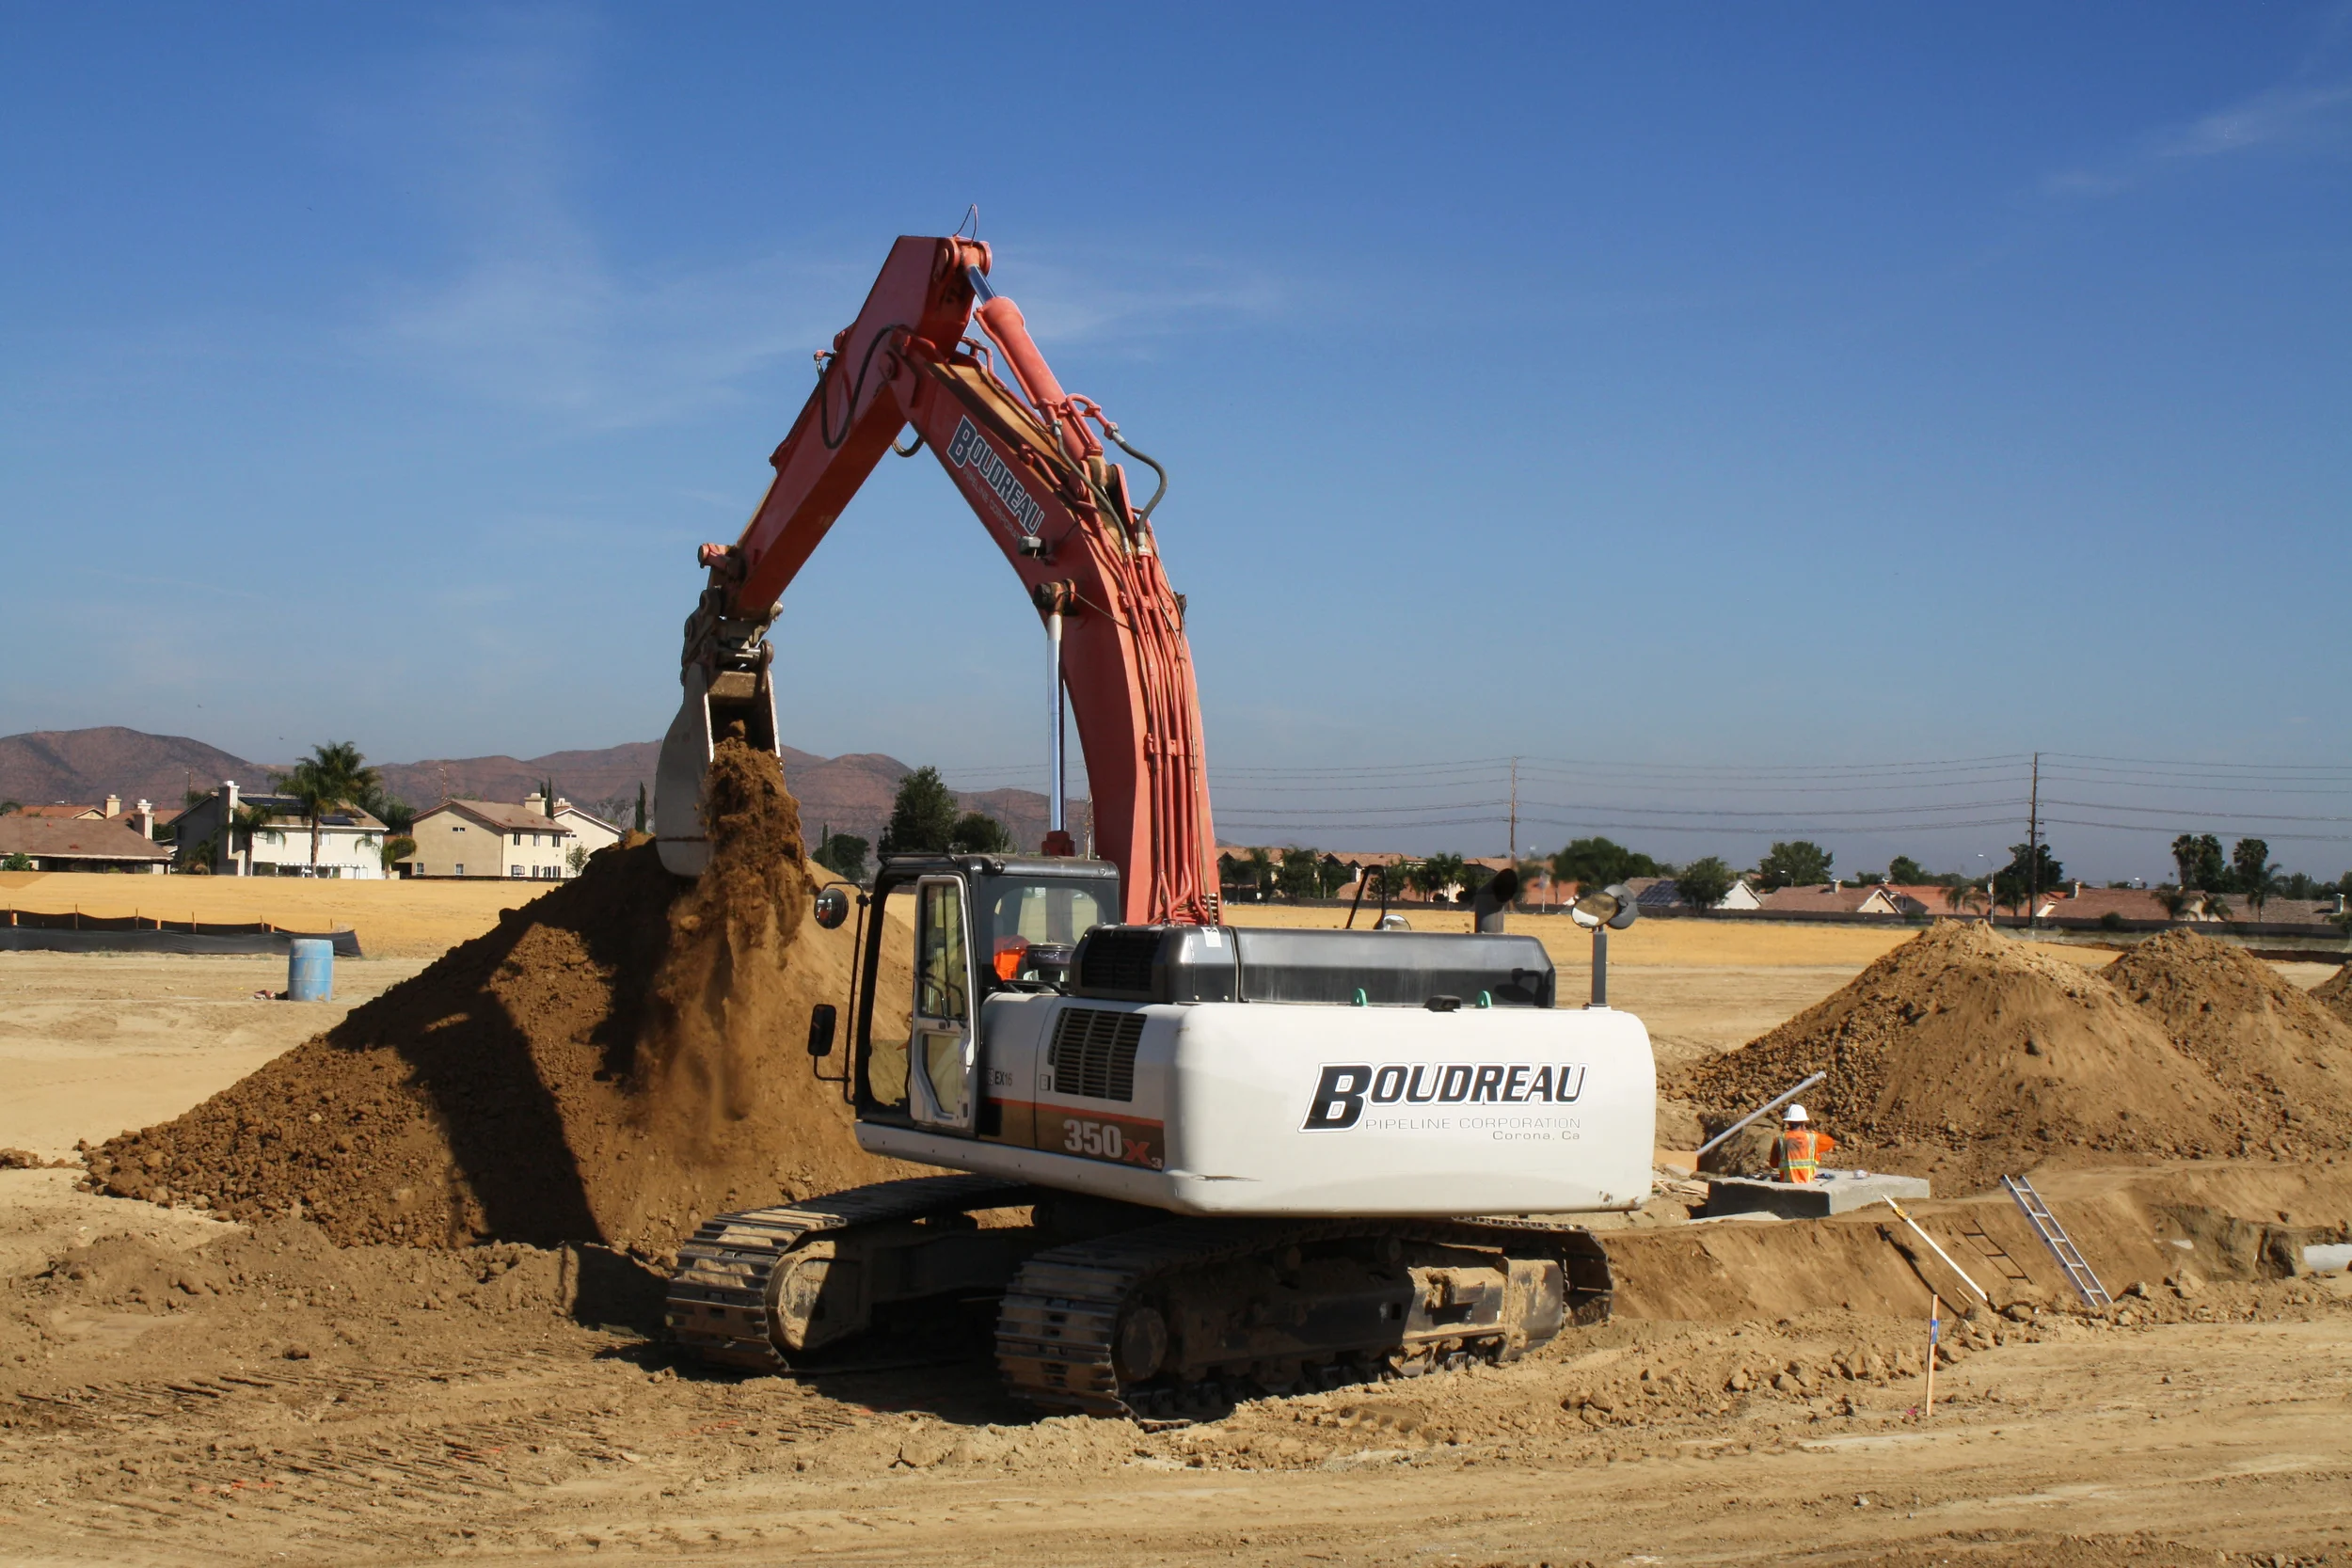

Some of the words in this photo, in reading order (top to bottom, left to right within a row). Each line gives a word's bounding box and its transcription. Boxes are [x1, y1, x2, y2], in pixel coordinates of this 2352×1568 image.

[946, 414, 1044, 536] BOUDREAU
[1297, 1062, 1588, 1132] BOUDREAU
[1365, 1118, 1451, 1130] PIPELINE
[1459, 1117, 1581, 1129] CORPORATION
[1562, 1131, 1581, 1140] Ca
